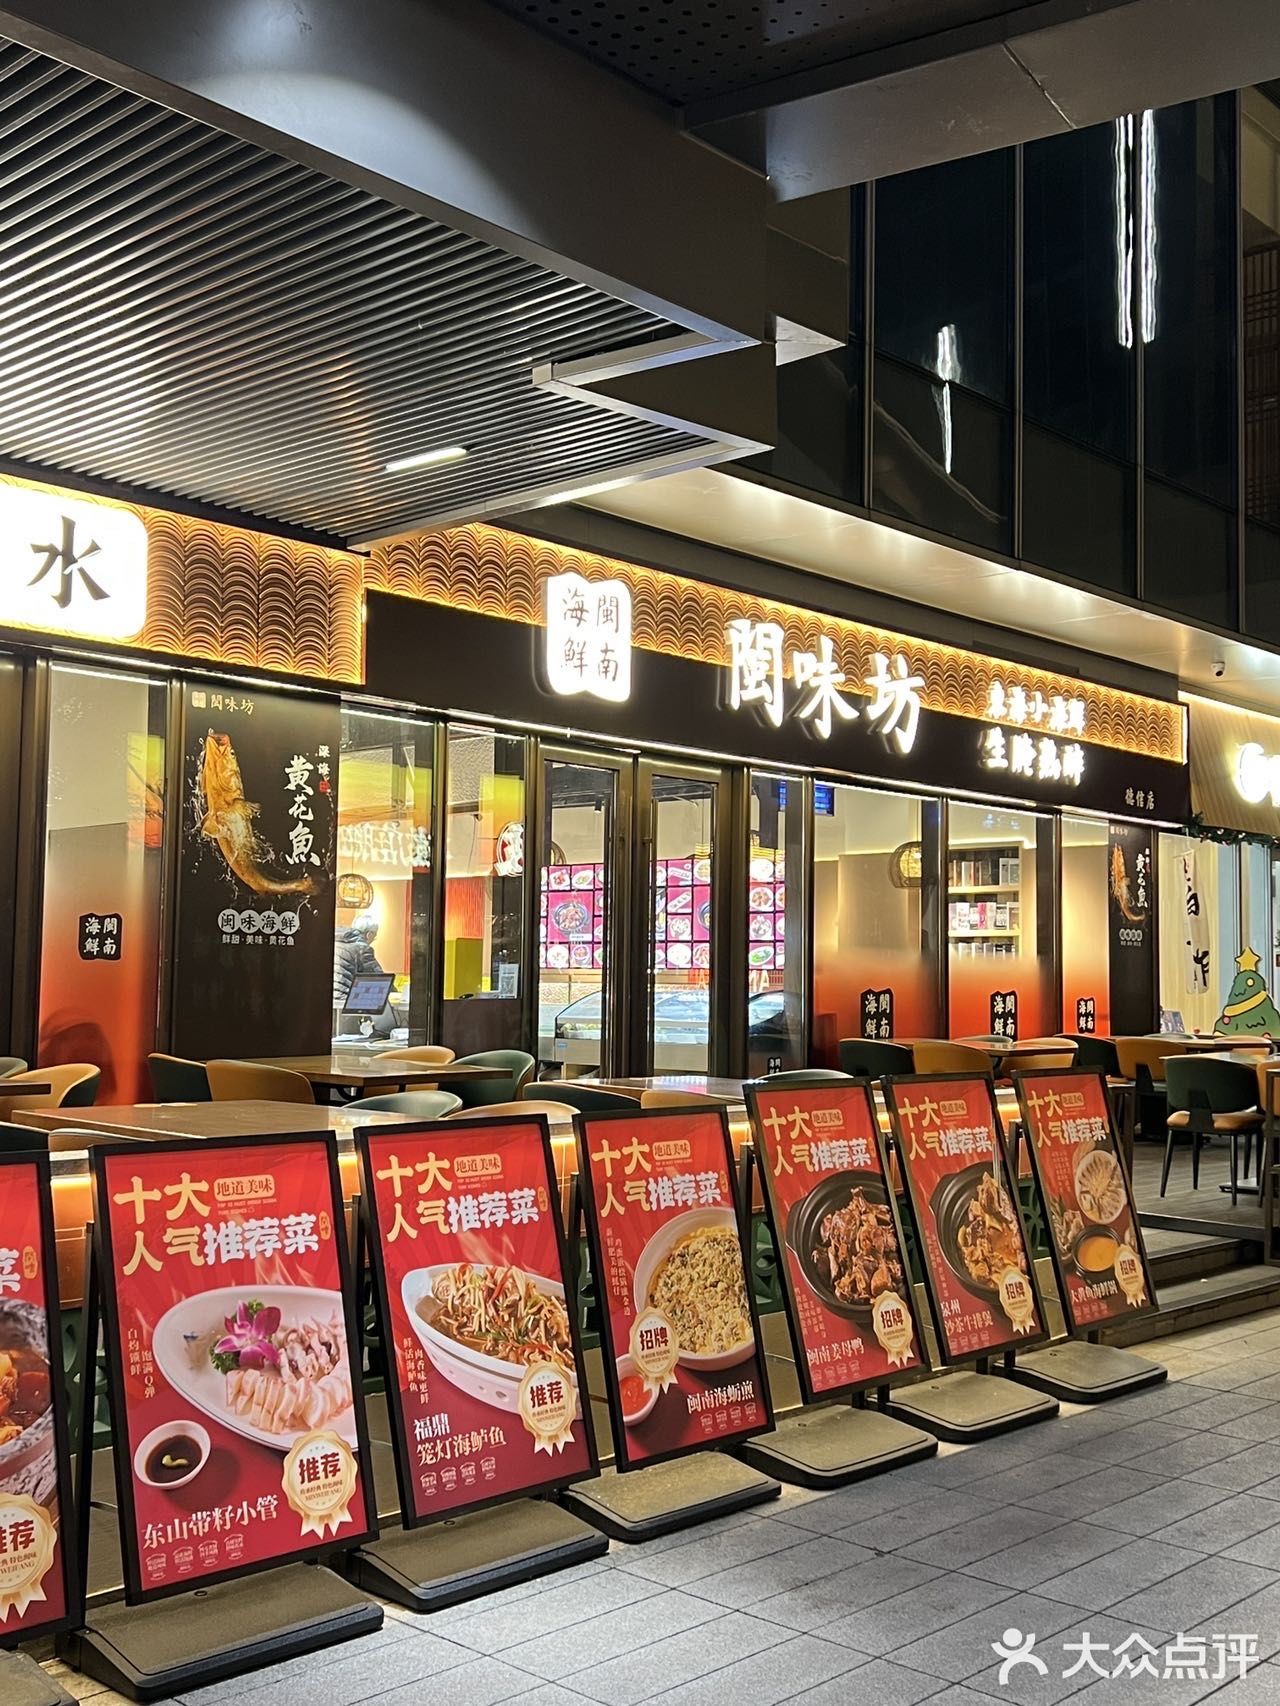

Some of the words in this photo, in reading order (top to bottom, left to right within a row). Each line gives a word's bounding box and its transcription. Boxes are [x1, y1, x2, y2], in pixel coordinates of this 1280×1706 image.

[27, 515, 111, 609] 水
[219, 910, 299, 934] 闽味海鲜
[898, 1096, 941, 1129] 十大
[1027, 1089, 1063, 1119] 十大
[762, 1105, 813, 1141] 十大
[1037, 1116, 1106, 1148] 人气推荐菜
[591, 1137, 652, 1178] 十大
[773, 1137, 872, 1177] 人气推荐菜
[909, 1126, 993, 1161] 人气推荐菜
[376, 1152, 453, 1198] 十大
[456, 1156, 501, 1173] 地道美味
[113, 1171, 211, 1225] 十大
[216, 1178, 274, 1197] 地道美味
[600, 1170, 721, 1218] 人气推荐菜
[386, 1187, 540, 1243] 人气推荐菜
[122, 1212, 319, 1276] 人气推荐菜
[1005, 1281, 1025, 1300] 招牌
[880, 1308, 904, 1329] 招牌
[640, 1326, 669, 1351] 招牌
[530, 1381, 563, 1408] 推荐
[413, 1412, 450, 1442] 福鼎
[299, 1452, 341, 1485] 推荐
[0, 1519, 35, 1554] 荐
[142, 1493, 279, 1550] 东山带籽小管
